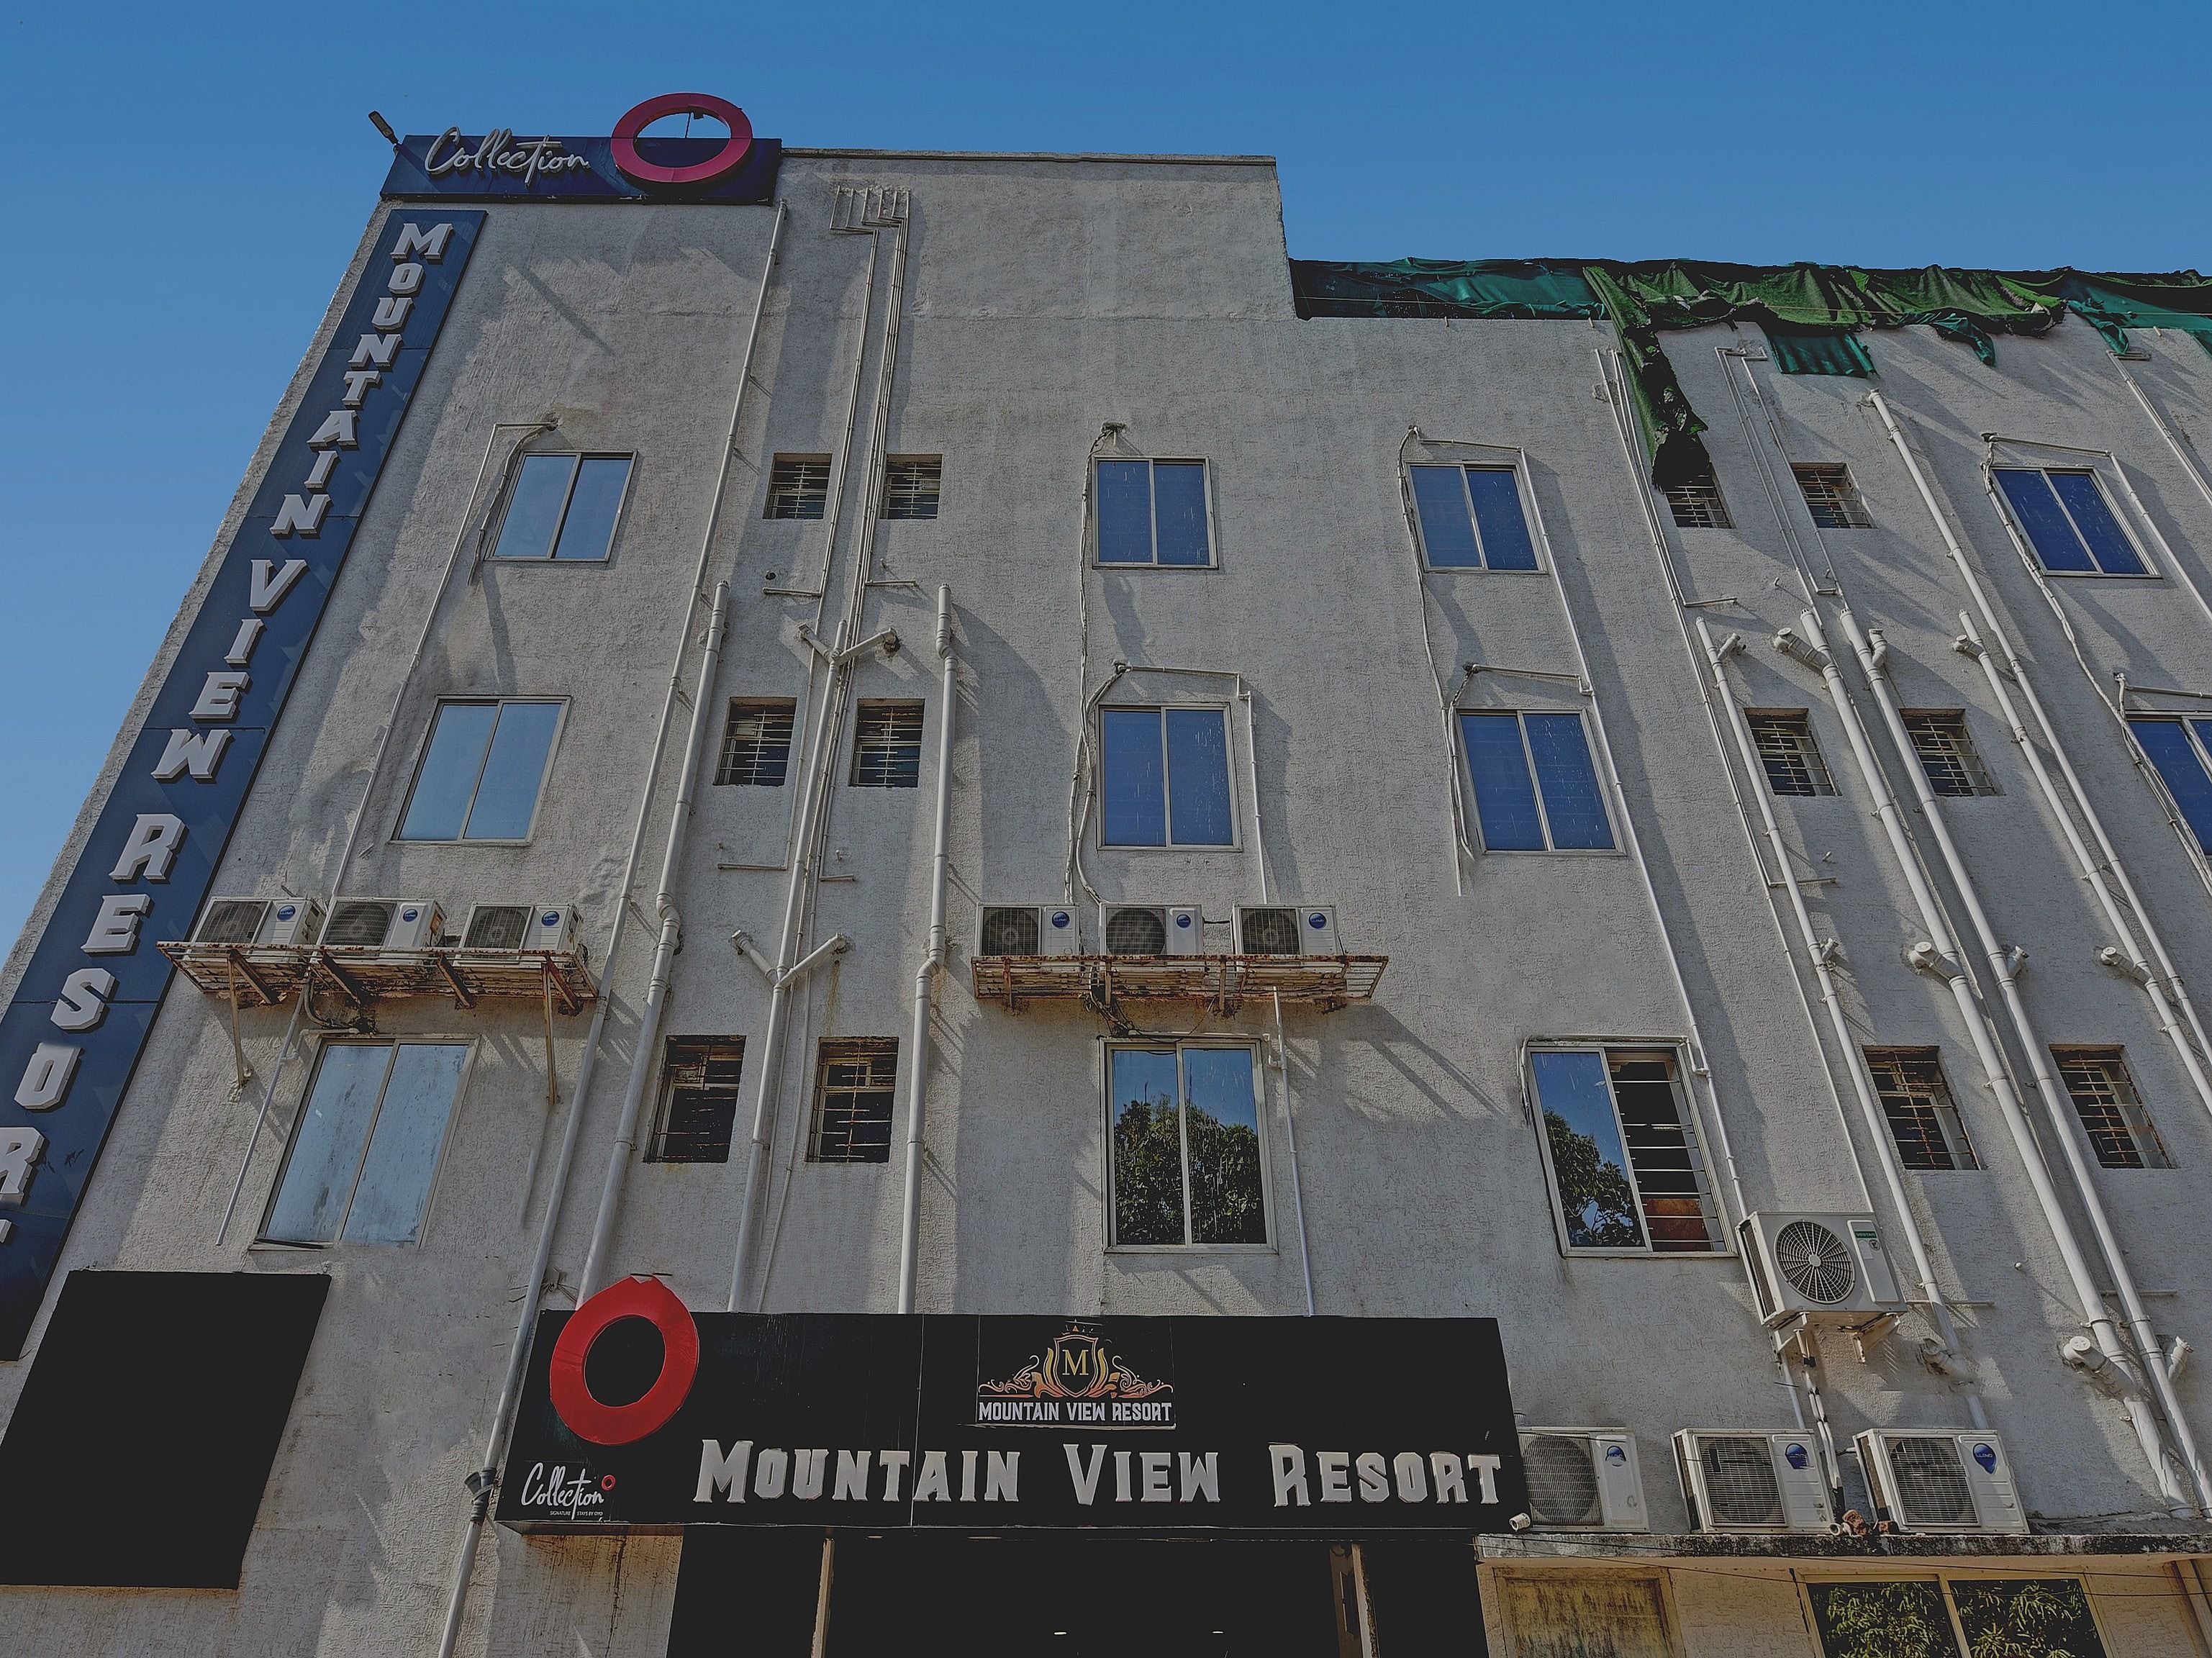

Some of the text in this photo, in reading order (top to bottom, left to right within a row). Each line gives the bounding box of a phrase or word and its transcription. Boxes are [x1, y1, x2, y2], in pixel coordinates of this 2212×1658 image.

[425, 126, 591, 186] Collection
[0, 223, 454, 1244] MOUNTAIN VIEW RESOR
[1062, 1349, 1089, 1376] M
[979, 1402, 1172, 1421] MOUNTAIN VIEW RESORT
[521, 1462, 604, 1520] Collection
[693, 1439, 1501, 1507] MOUNTAIN VIEW RESORT
